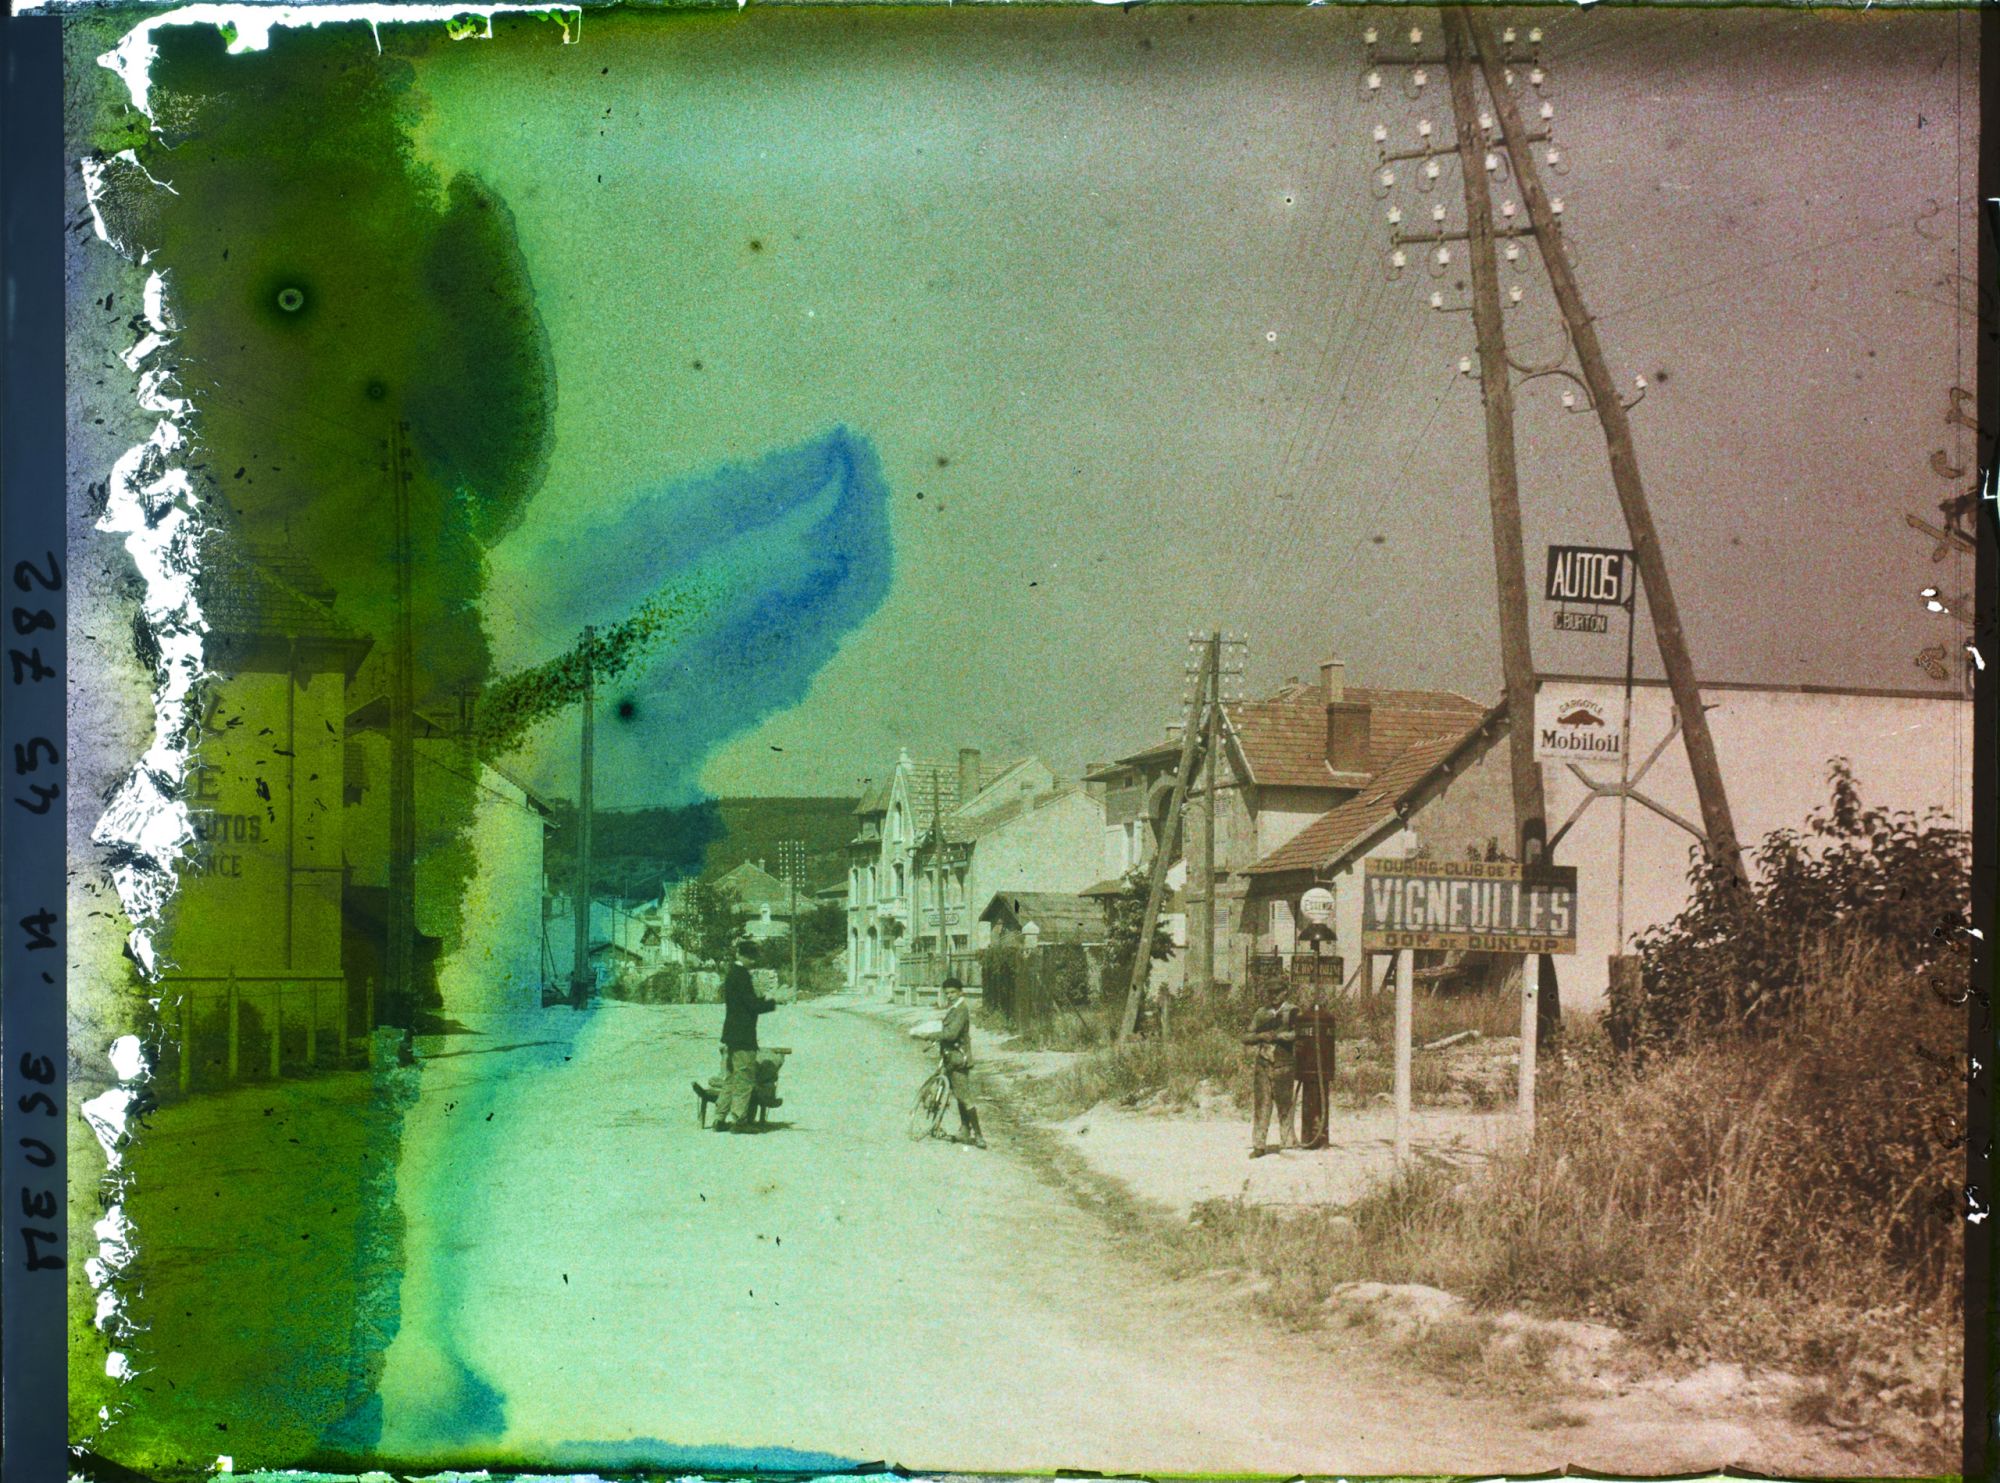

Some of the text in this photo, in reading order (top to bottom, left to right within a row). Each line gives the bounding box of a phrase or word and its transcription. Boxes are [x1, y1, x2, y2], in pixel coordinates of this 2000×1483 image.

[1552, 551, 1619, 600] AUTOS
[9, 551, 62, 685] 782
[1541, 730, 1619, 752] Mobiloil
[15, 738, 59, 815] 45
[1488, 865, 1504, 877] DE
[1371, 878, 1570, 936] VIGNEULLES
[1440, 938, 1457, 948] DE
[19, 1053, 64, 1272] MEUSE
